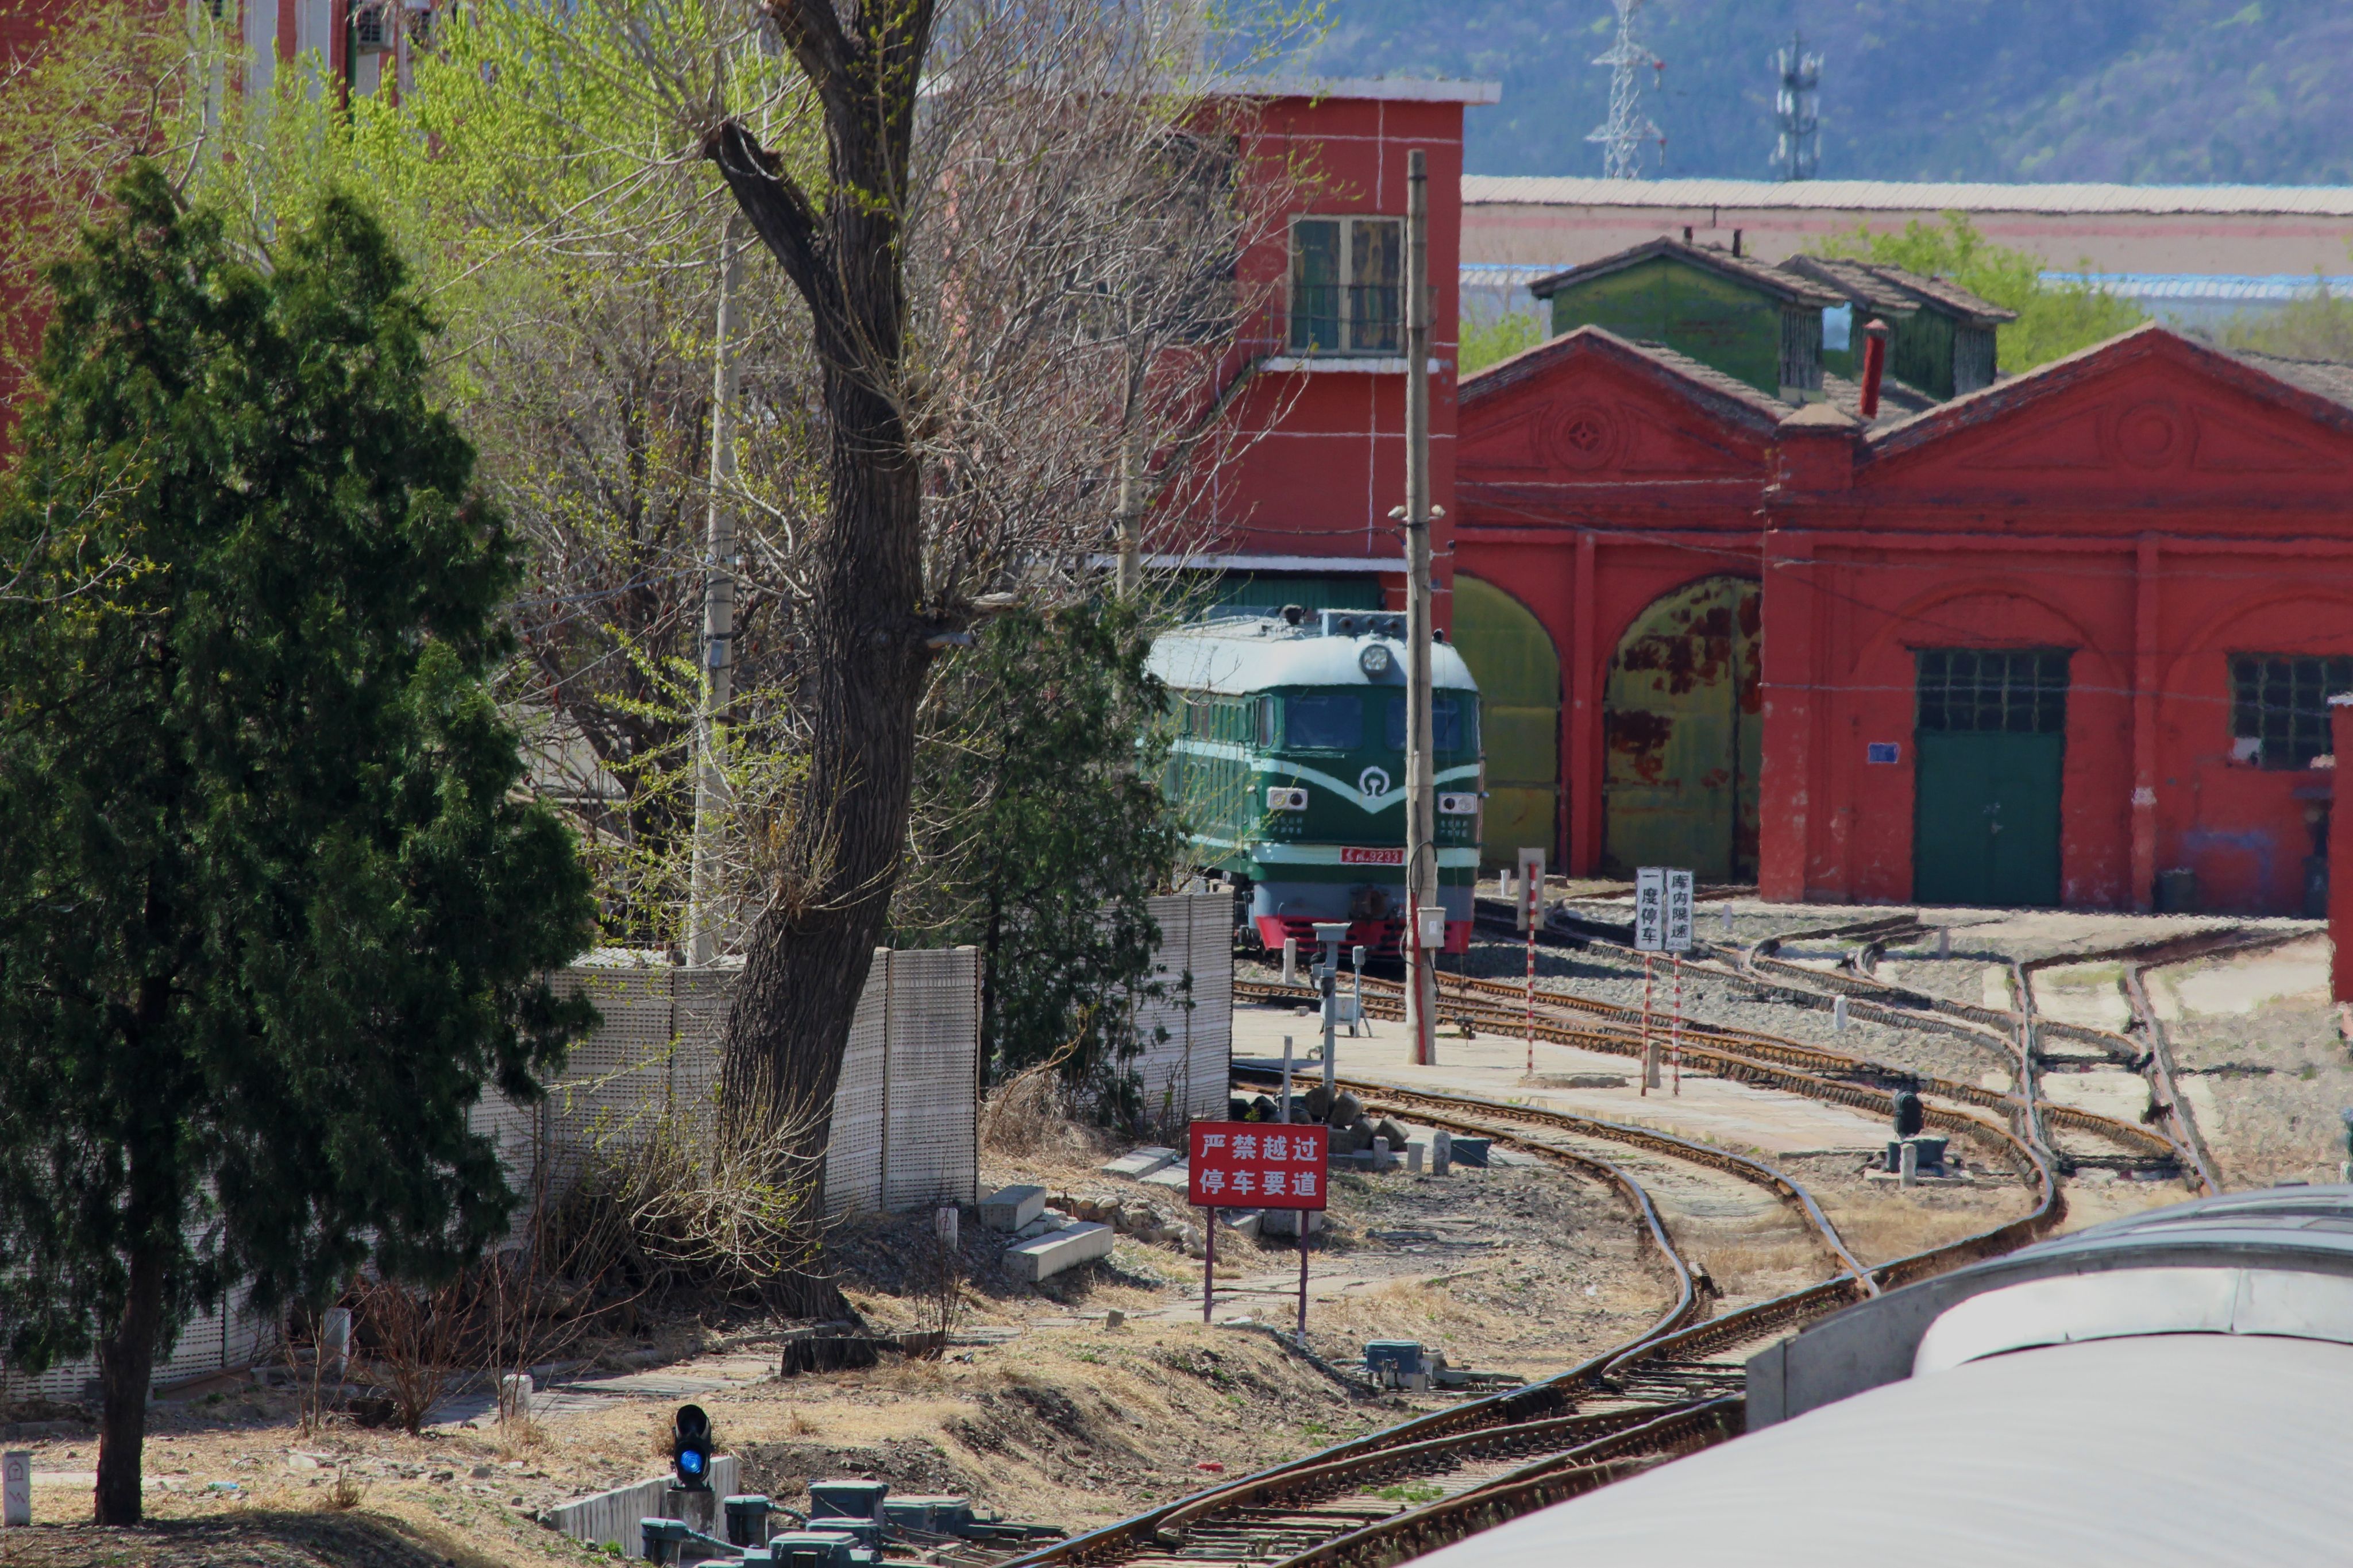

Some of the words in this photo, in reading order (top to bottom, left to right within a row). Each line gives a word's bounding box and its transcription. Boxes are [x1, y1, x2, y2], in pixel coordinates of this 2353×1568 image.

[1641, 873, 1659, 945] 一度停车
[1671, 874, 1689, 939] 库内限速
[1200, 1133, 1318, 1162] 严禁越过
[1199, 1168, 1317, 1196] 停车要道
